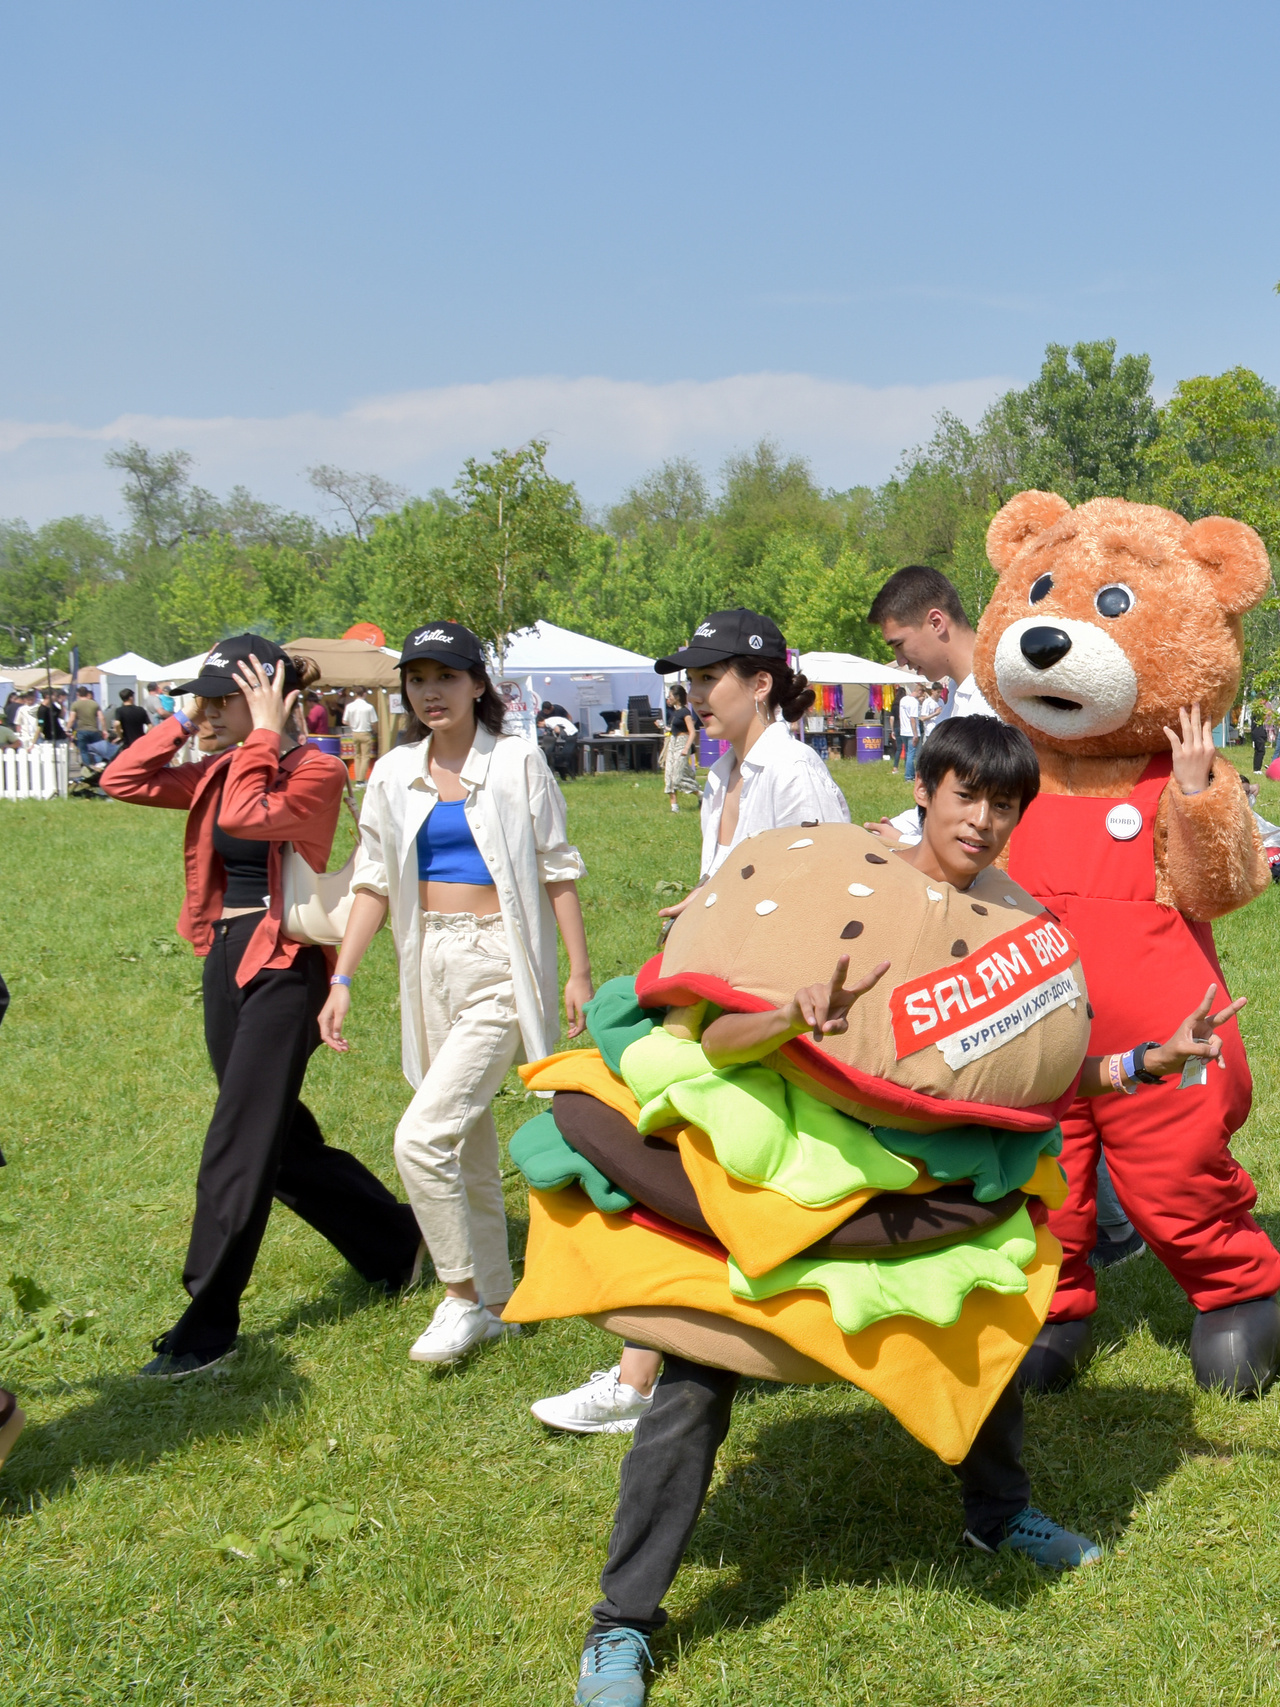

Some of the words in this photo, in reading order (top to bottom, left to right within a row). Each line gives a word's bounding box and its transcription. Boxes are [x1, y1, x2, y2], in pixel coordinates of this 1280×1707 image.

[414, 629, 454, 646] Chillax
[1110, 817, 1136, 826] BOBBY
[904, 942, 1033, 1035] SALAM
[1024, 921, 1070, 967] BRO
[960, 1010, 1023, 1053] БУРГЕРЫ
[1023, 1003, 1033, 1018] И
[1031, 979, 1074, 1012] ХОТ-ДОГИ
